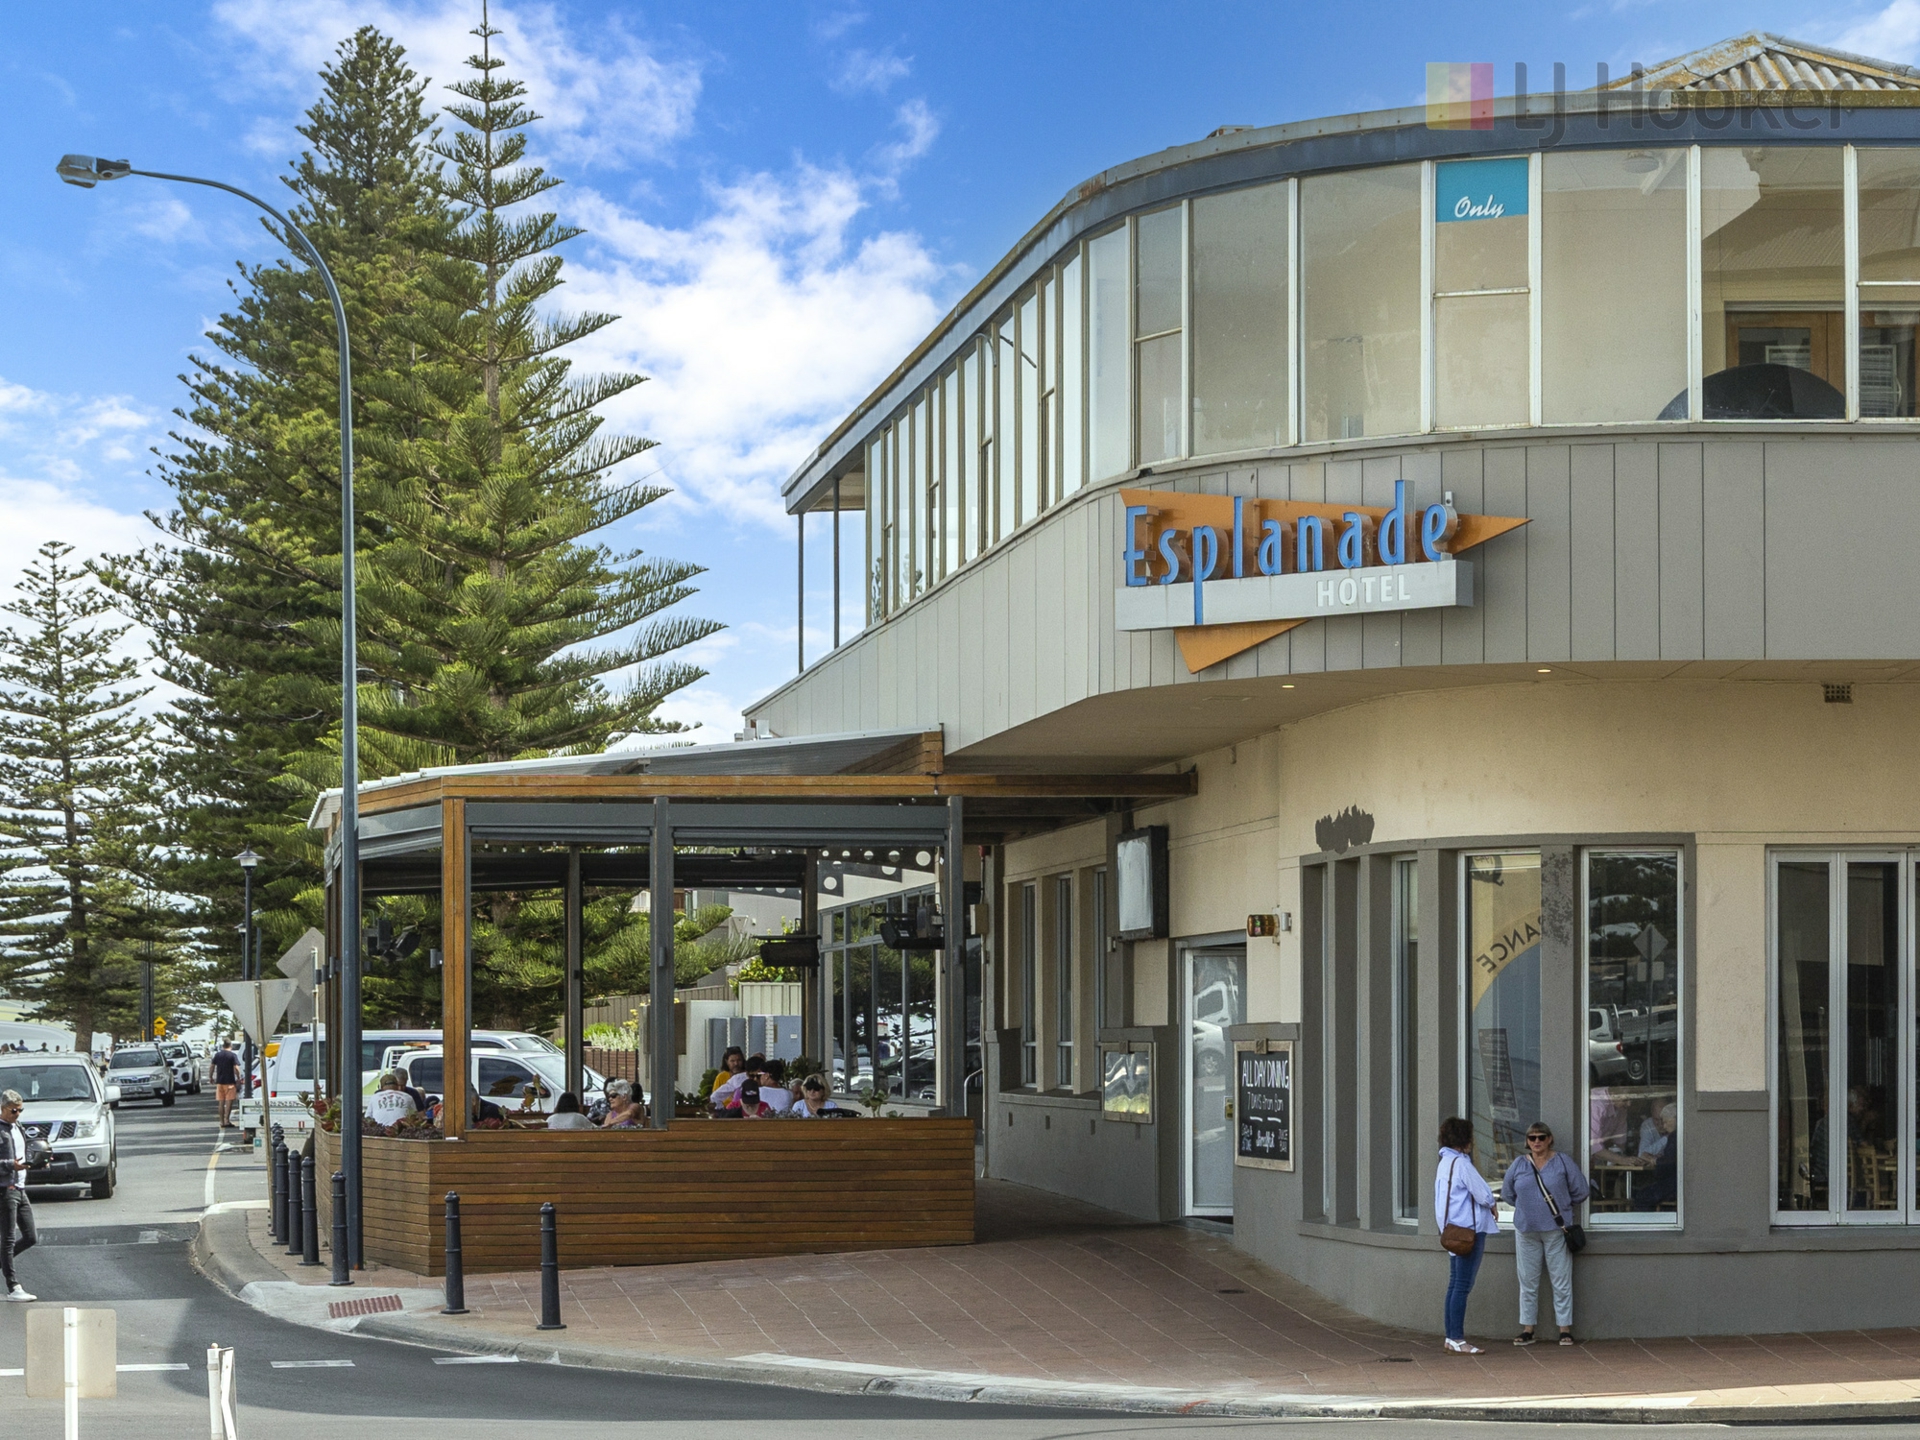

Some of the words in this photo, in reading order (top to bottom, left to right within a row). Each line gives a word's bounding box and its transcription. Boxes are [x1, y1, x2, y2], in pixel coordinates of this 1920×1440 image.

[1454, 194, 1505, 218] Only
[1123, 480, 1452, 625] Esplanade
[1316, 574, 1411, 607] HOTEL
[1242, 1060, 1253, 1087] ALL
[1254, 1060, 1266, 1088] DAY
[1267, 1060, 1290, 1089] DINING
